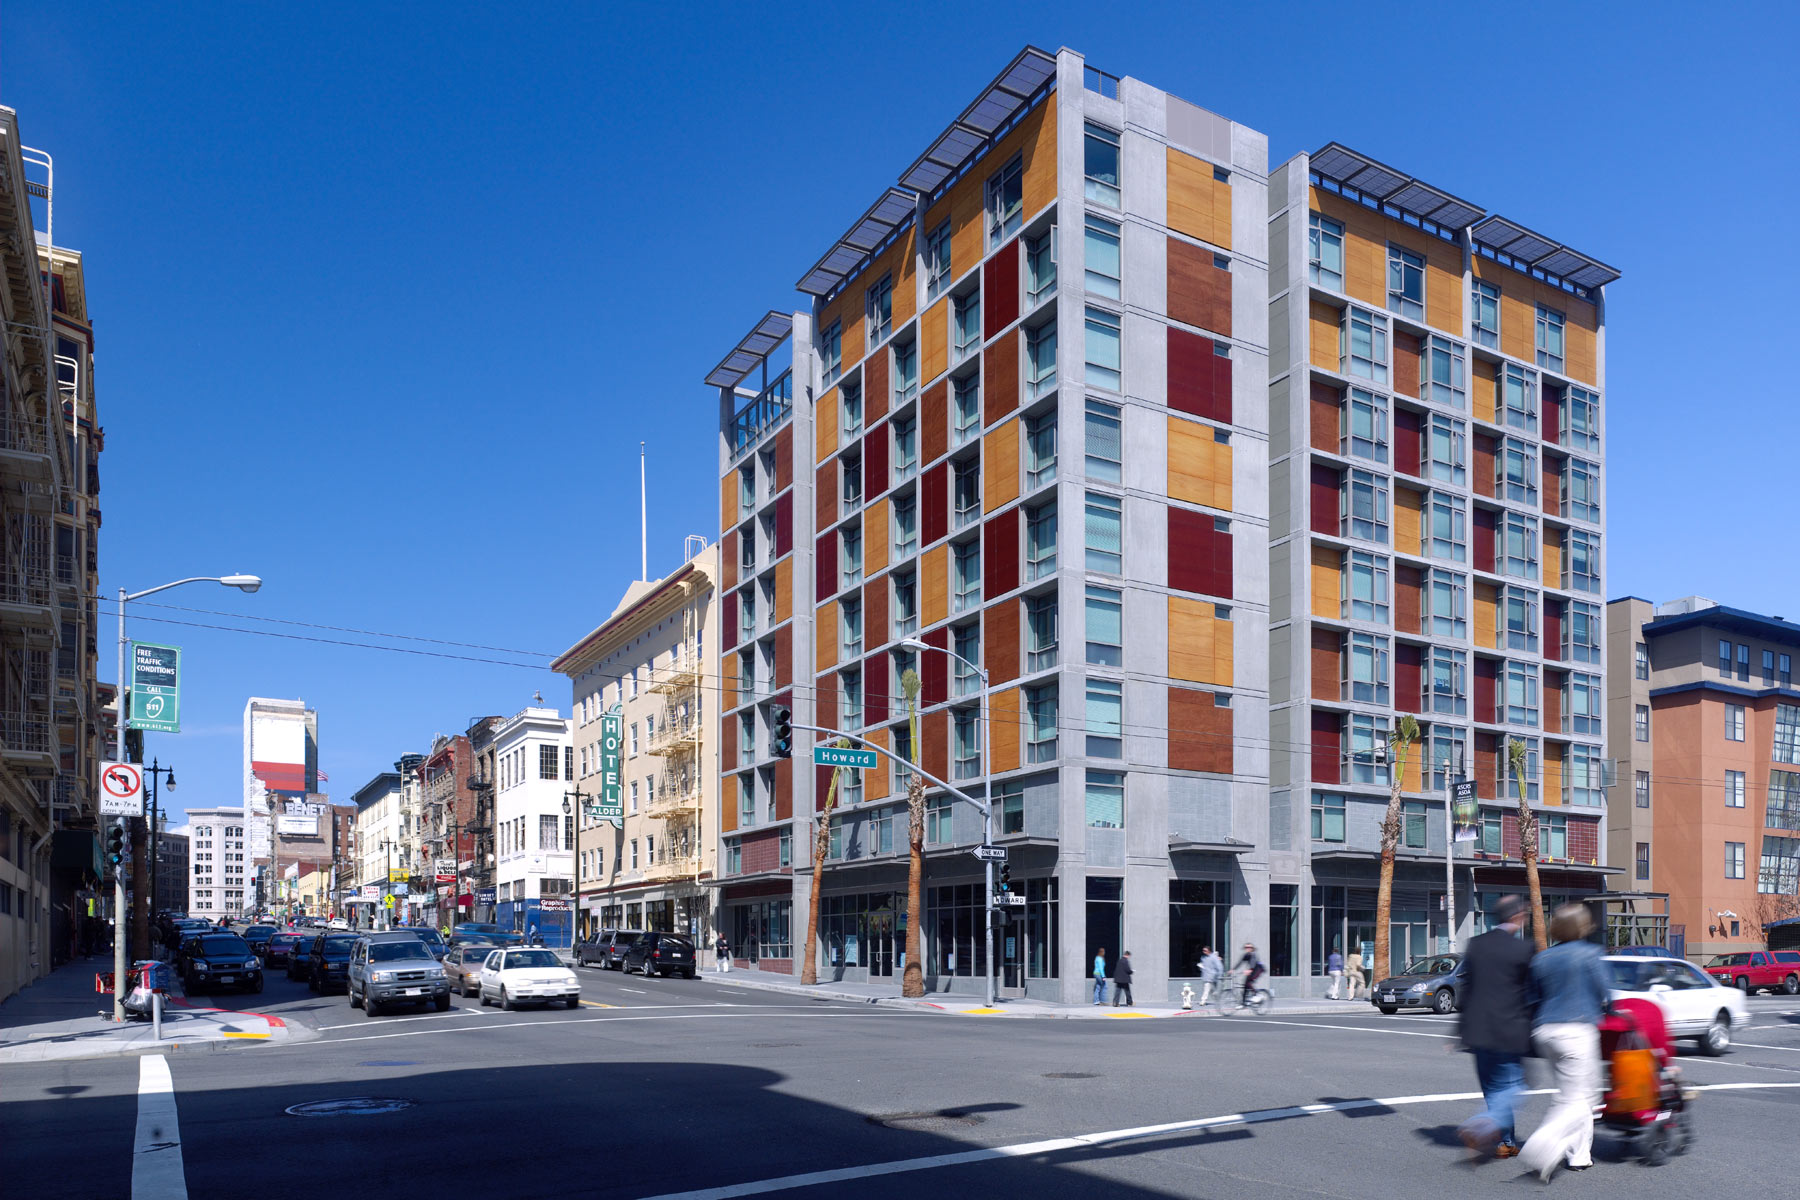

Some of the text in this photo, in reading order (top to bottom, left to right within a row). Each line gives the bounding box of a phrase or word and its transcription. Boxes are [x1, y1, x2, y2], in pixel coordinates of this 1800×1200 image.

[137, 648, 152, 657] FREE
[137, 656, 162, 666] TRAFFIC
[136, 664, 175, 676] CONDITIONS
[146, 703, 159, 711] 511
[605, 719, 617, 803] HOTEL
[822, 751, 869, 764] Howard
[591, 807, 622, 816] ALDER
[995, 896, 1024, 905] HOWARD
